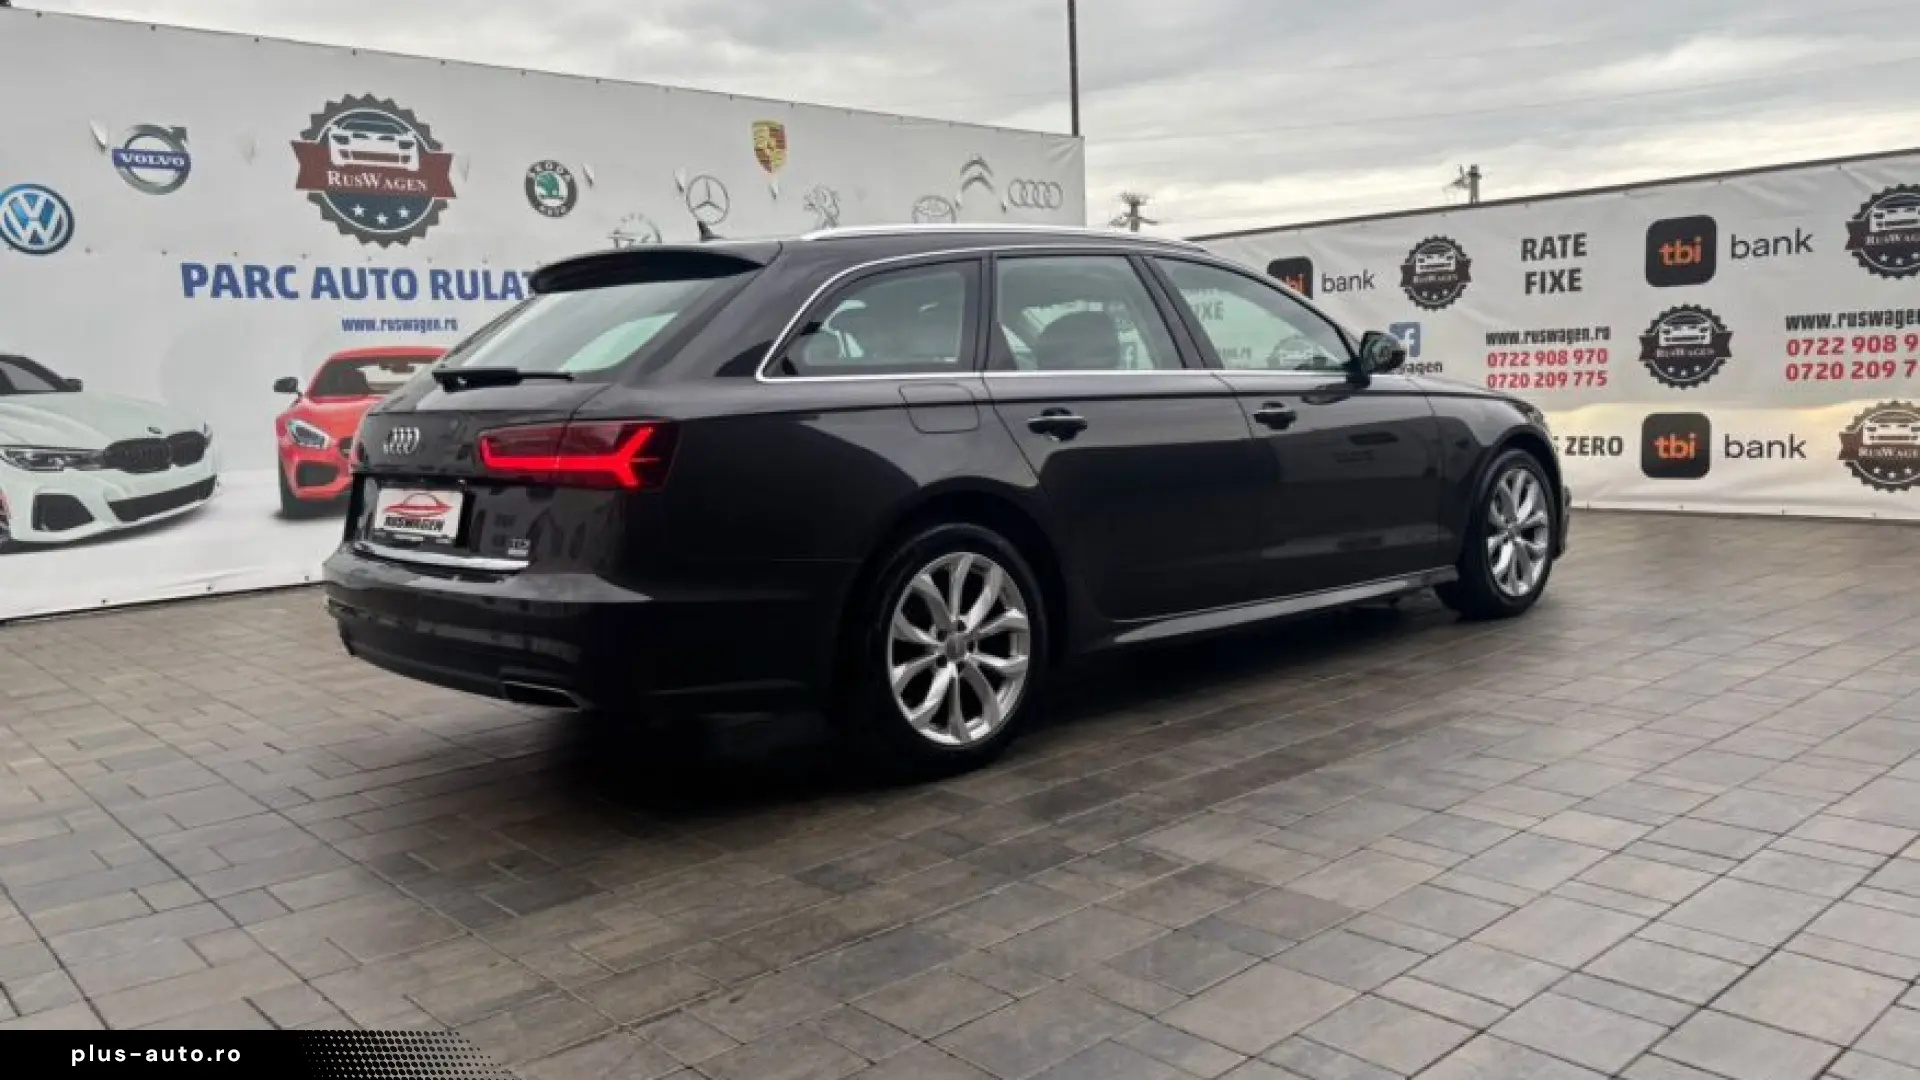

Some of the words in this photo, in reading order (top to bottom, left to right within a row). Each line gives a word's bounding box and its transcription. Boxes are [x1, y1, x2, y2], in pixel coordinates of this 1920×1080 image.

[120, 152, 185, 167] VOLVO
[1521, 231, 1587, 262] RATE
[1659, 236, 1702, 266] tbi
[1731, 226, 1814, 260] bank
[180, 261, 299, 300] PARC
[310, 265, 419, 301] AUTO
[1321, 269, 1375, 293] bank
[1524, 267, 1583, 295] FIXE
[341, 317, 459, 334] www.ruswagen.ro
[1485, 326, 1612, 345] www.ruswagen.ro
[1786, 337, 1845, 357] 0722
[1851, 334, 1897, 354] 908
[1487, 352, 1530, 368] 0722
[1533, 350, 1569, 367] 908
[1573, 347, 1609, 365] 970
[1487, 373, 1530, 389] 0720
[1533, 371, 1569, 389] 209
[1573, 369, 1608, 387] 775
[1786, 360, 1845, 381] 0720
[1850, 360, 1897, 380] 209
[1564, 435, 1624, 457] ZERO
[1655, 432, 1697, 459] tbi
[1724, 433, 1807, 459] bank
